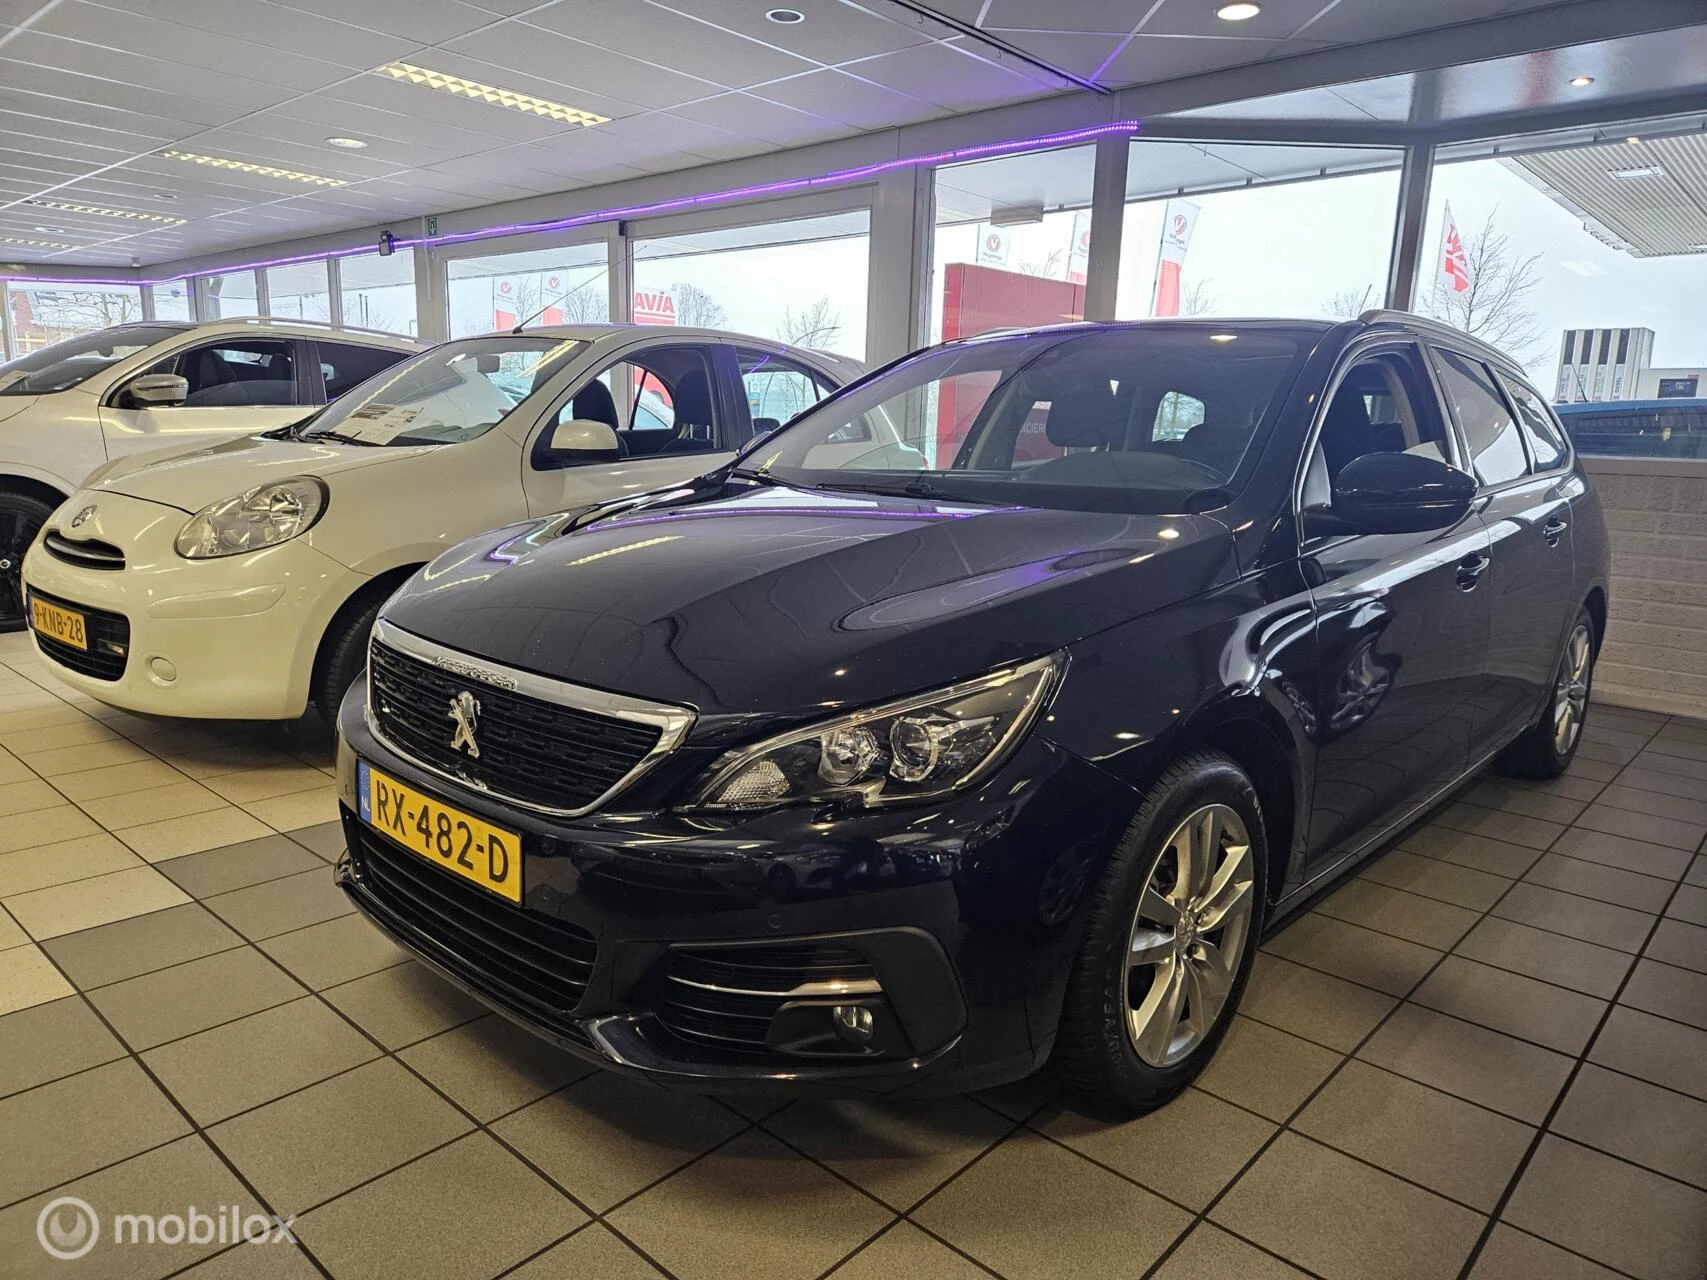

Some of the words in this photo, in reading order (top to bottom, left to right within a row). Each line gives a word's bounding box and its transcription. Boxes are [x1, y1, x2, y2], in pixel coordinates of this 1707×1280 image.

[33, 603, 84, 643] 9-KNB-28
[361, 796, 371, 812] NL
[376, 779, 509, 883] RX-482-D
